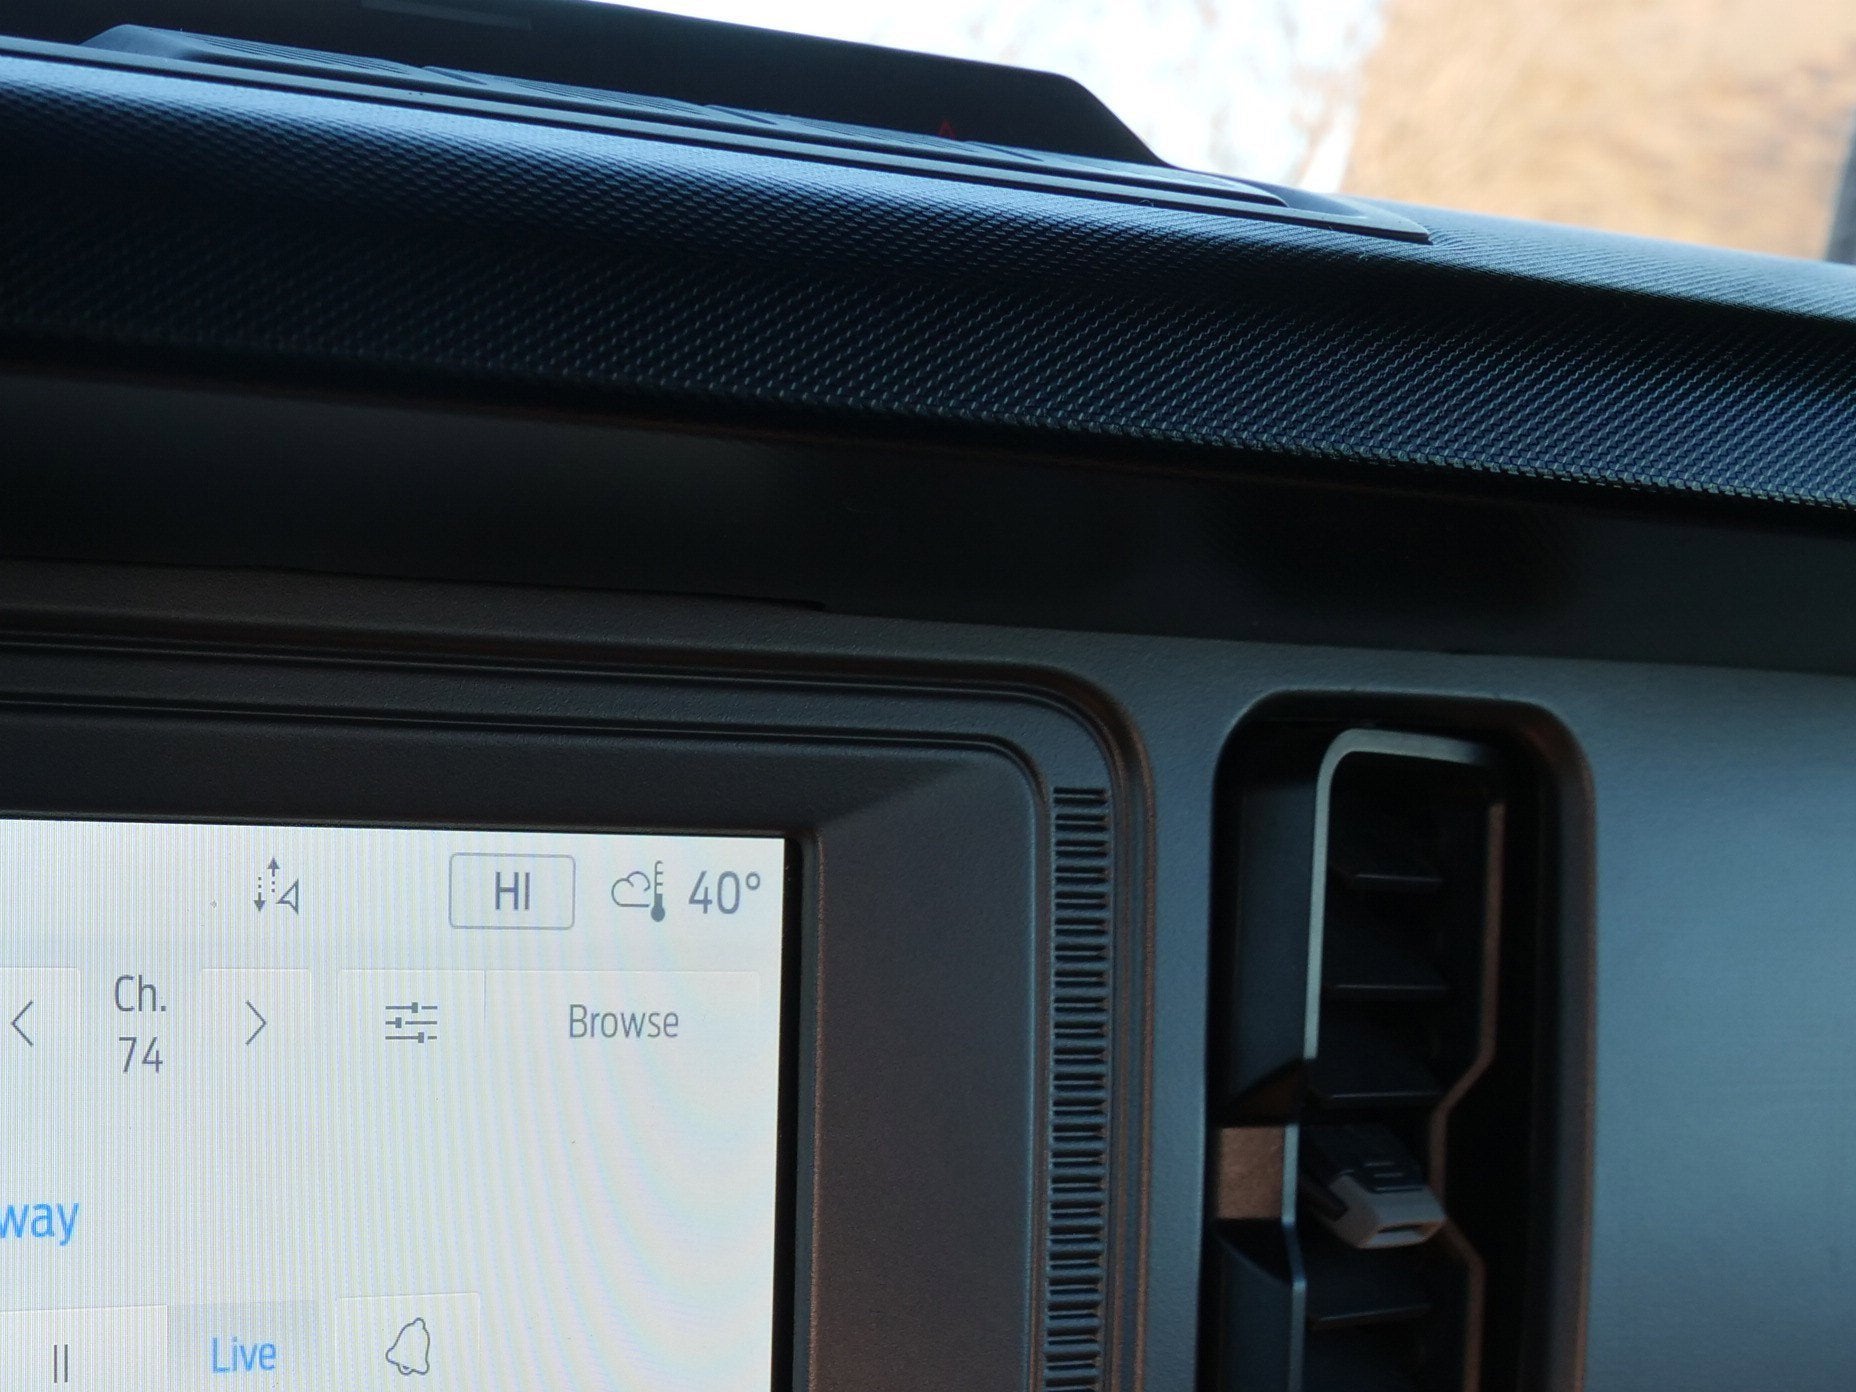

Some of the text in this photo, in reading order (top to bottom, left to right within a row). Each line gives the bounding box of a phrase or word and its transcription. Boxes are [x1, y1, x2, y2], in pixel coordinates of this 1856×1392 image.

[494, 871, 531, 912] HI
[688, 870, 762, 916] 40°
[113, 974, 167, 1013] Ch.
[568, 1003, 680, 1040] Browse
[118, 1036, 164, 1074] 74
[211, 1336, 278, 1373] Live
